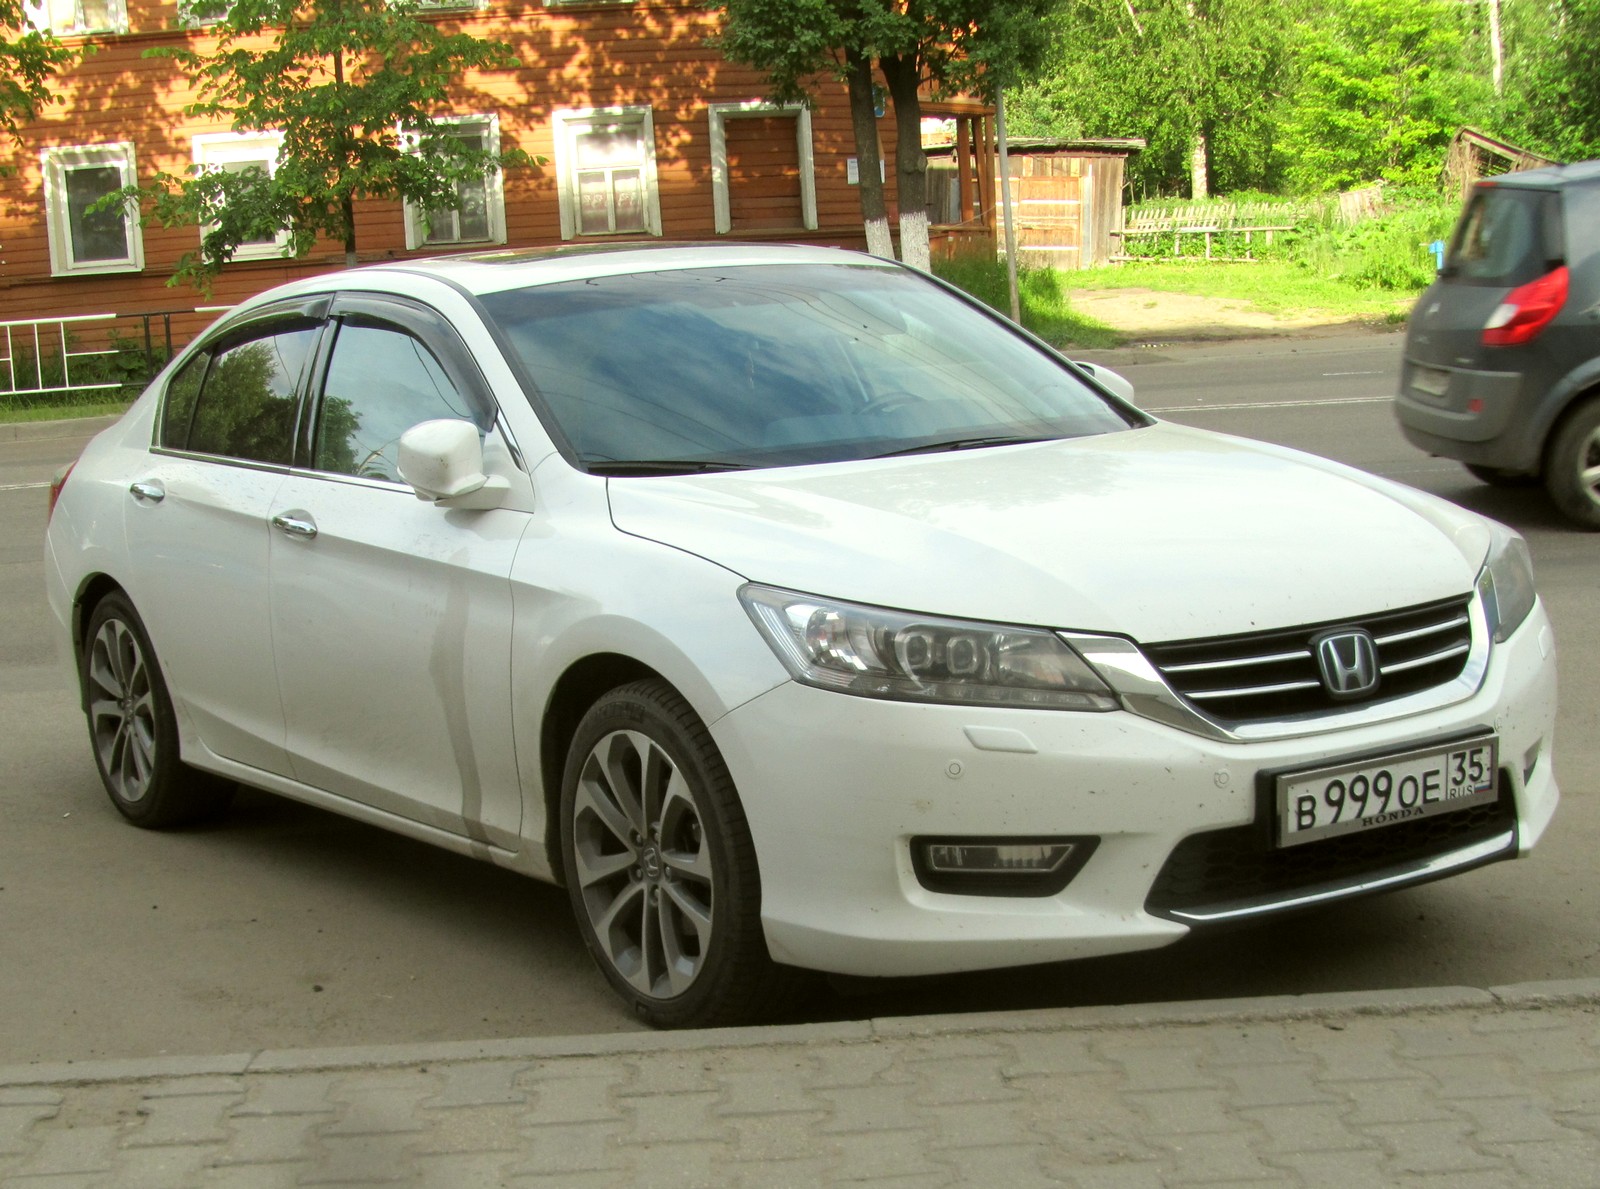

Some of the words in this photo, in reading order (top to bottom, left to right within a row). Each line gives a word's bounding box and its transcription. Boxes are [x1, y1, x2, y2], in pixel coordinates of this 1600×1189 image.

[1452, 748, 1484, 786] 35
[1450, 785, 1474, 799] RUS
[1362, 807, 1425, 827] HONDA
